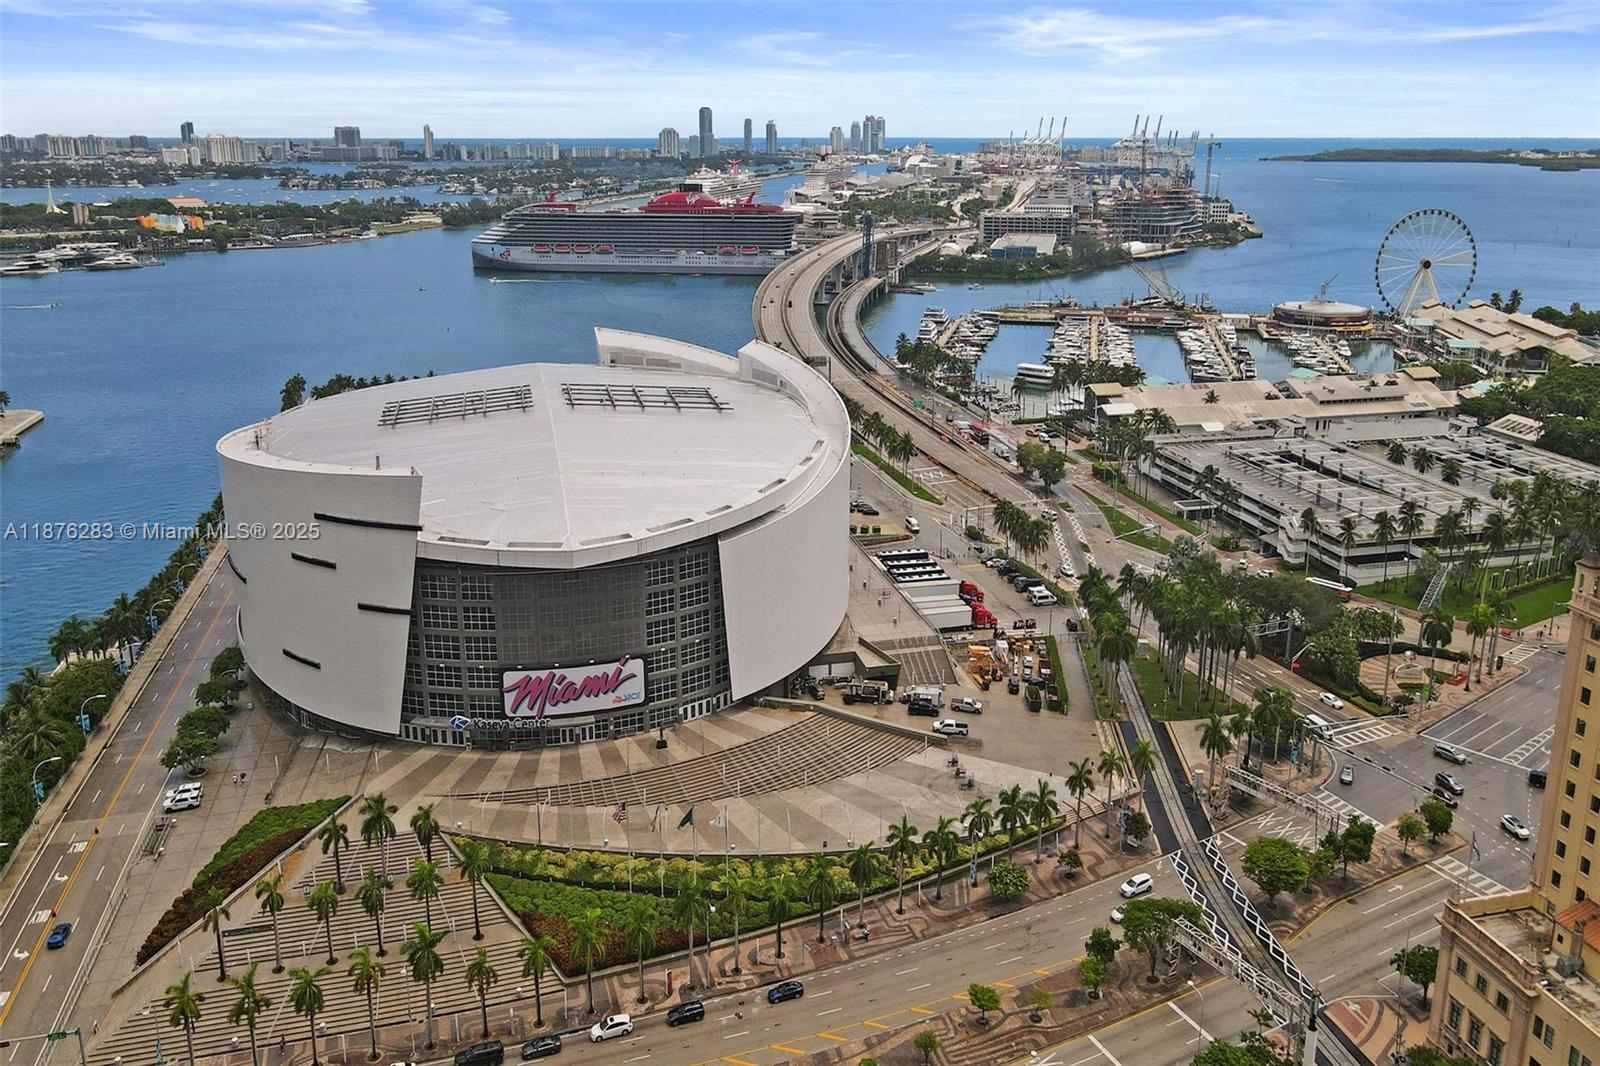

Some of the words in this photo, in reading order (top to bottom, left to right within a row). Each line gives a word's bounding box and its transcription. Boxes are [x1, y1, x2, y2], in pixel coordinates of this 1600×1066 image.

[503, 658, 636, 718] Miami
[473, 718, 508, 733] Kaseya
[514, 718, 551, 732] Center
